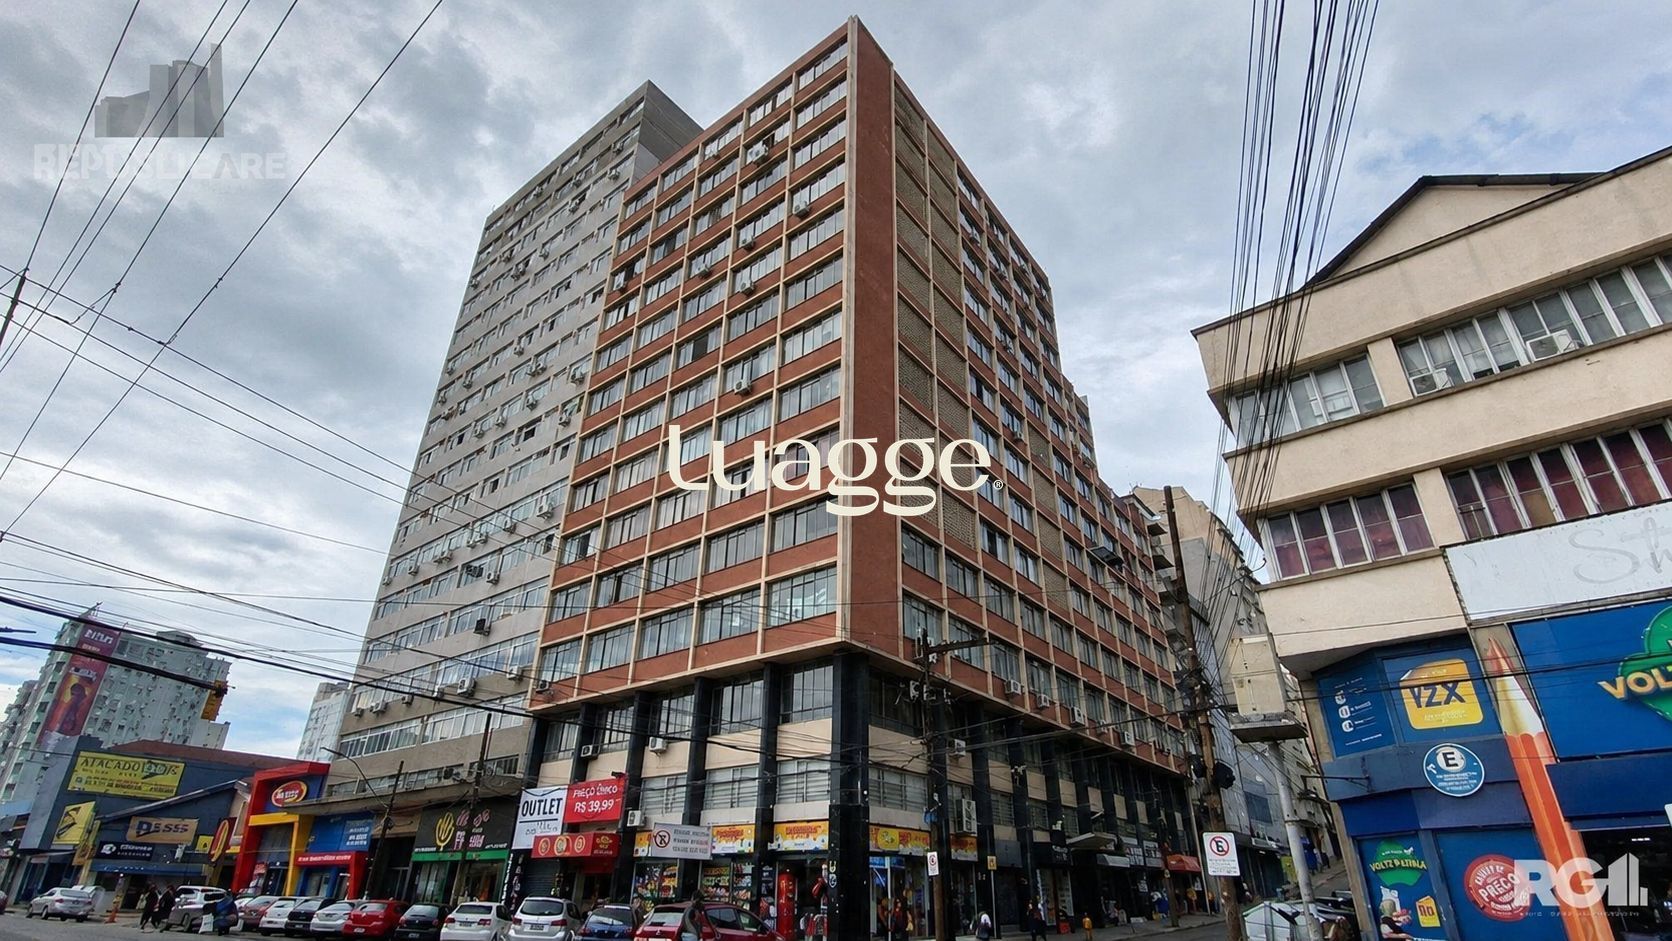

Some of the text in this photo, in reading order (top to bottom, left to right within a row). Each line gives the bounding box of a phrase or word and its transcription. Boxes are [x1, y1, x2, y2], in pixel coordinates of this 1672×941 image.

[1442, 751, 1459, 768] E
[521, 797, 564, 817] OUTLET
[587, 798, 615, 814] 39,99
